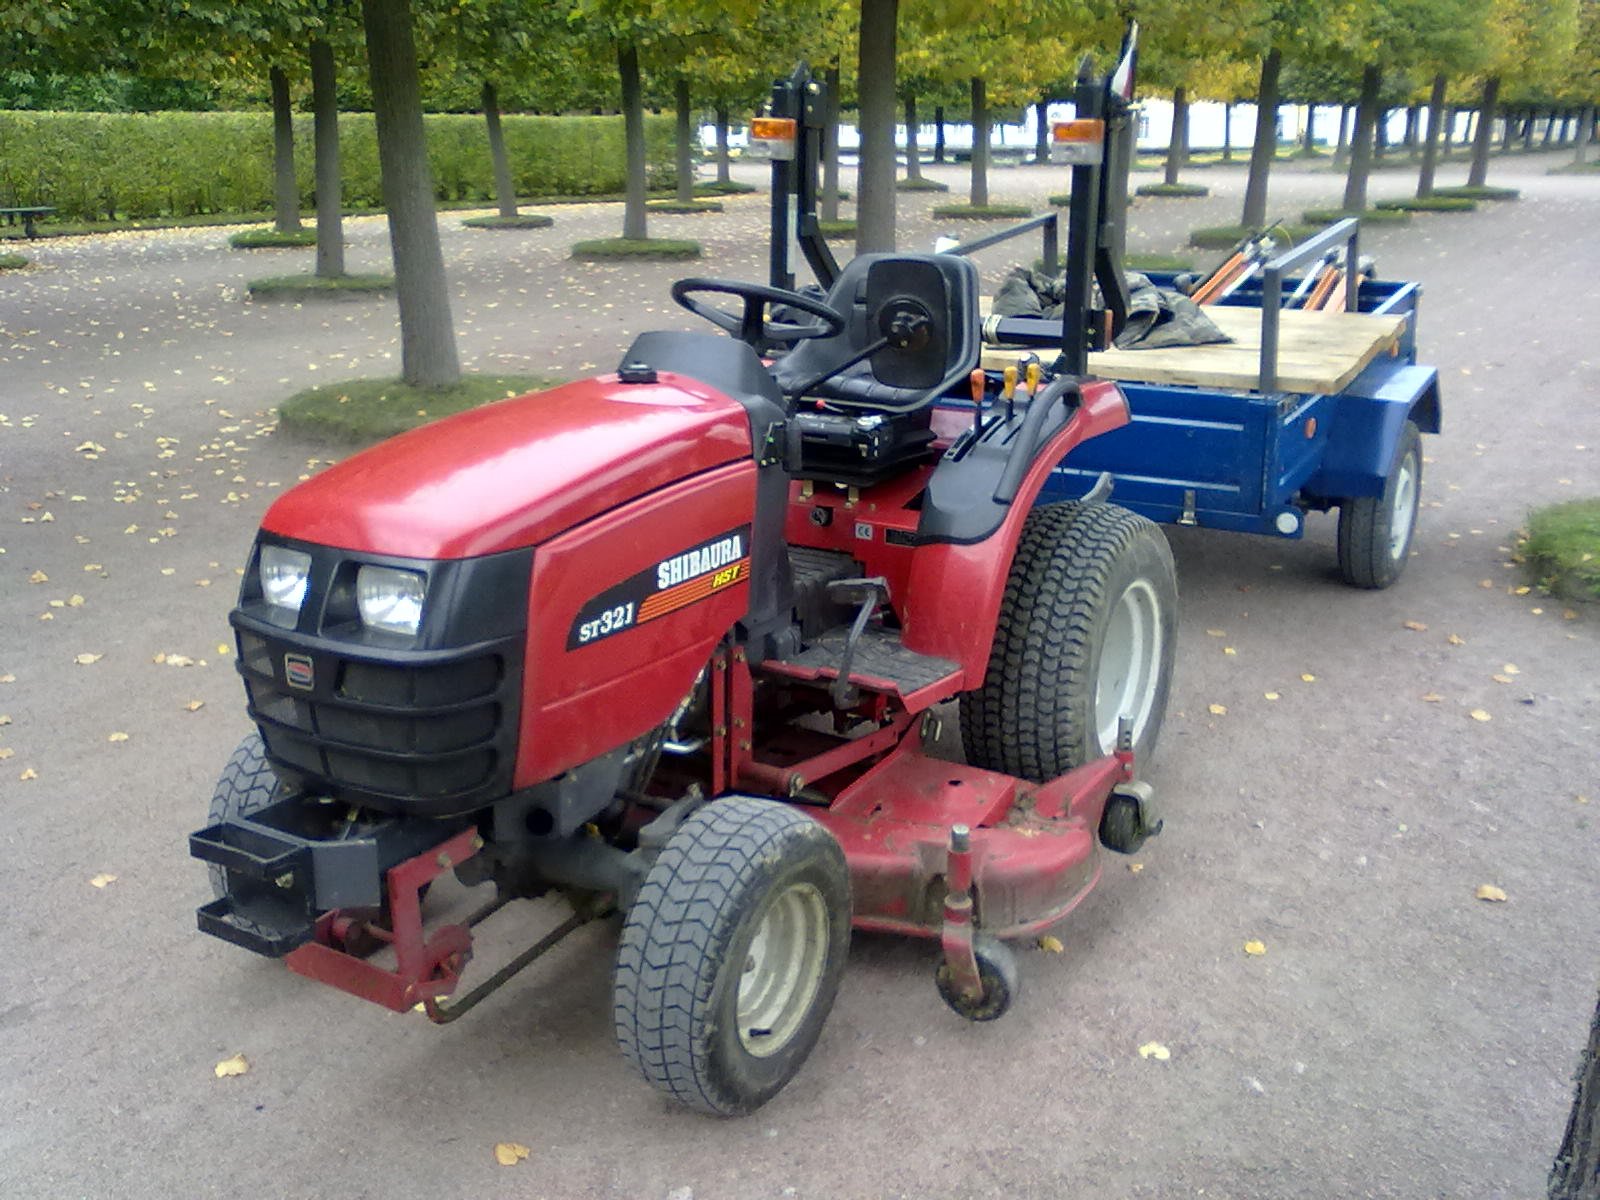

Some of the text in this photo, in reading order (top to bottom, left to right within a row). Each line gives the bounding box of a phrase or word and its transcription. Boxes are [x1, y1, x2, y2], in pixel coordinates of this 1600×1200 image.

[858, 525, 870, 537] CE
[657, 535, 742, 589] SHIBAURA
[712, 565, 740, 588] HST
[579, 602, 634, 642] ST321
